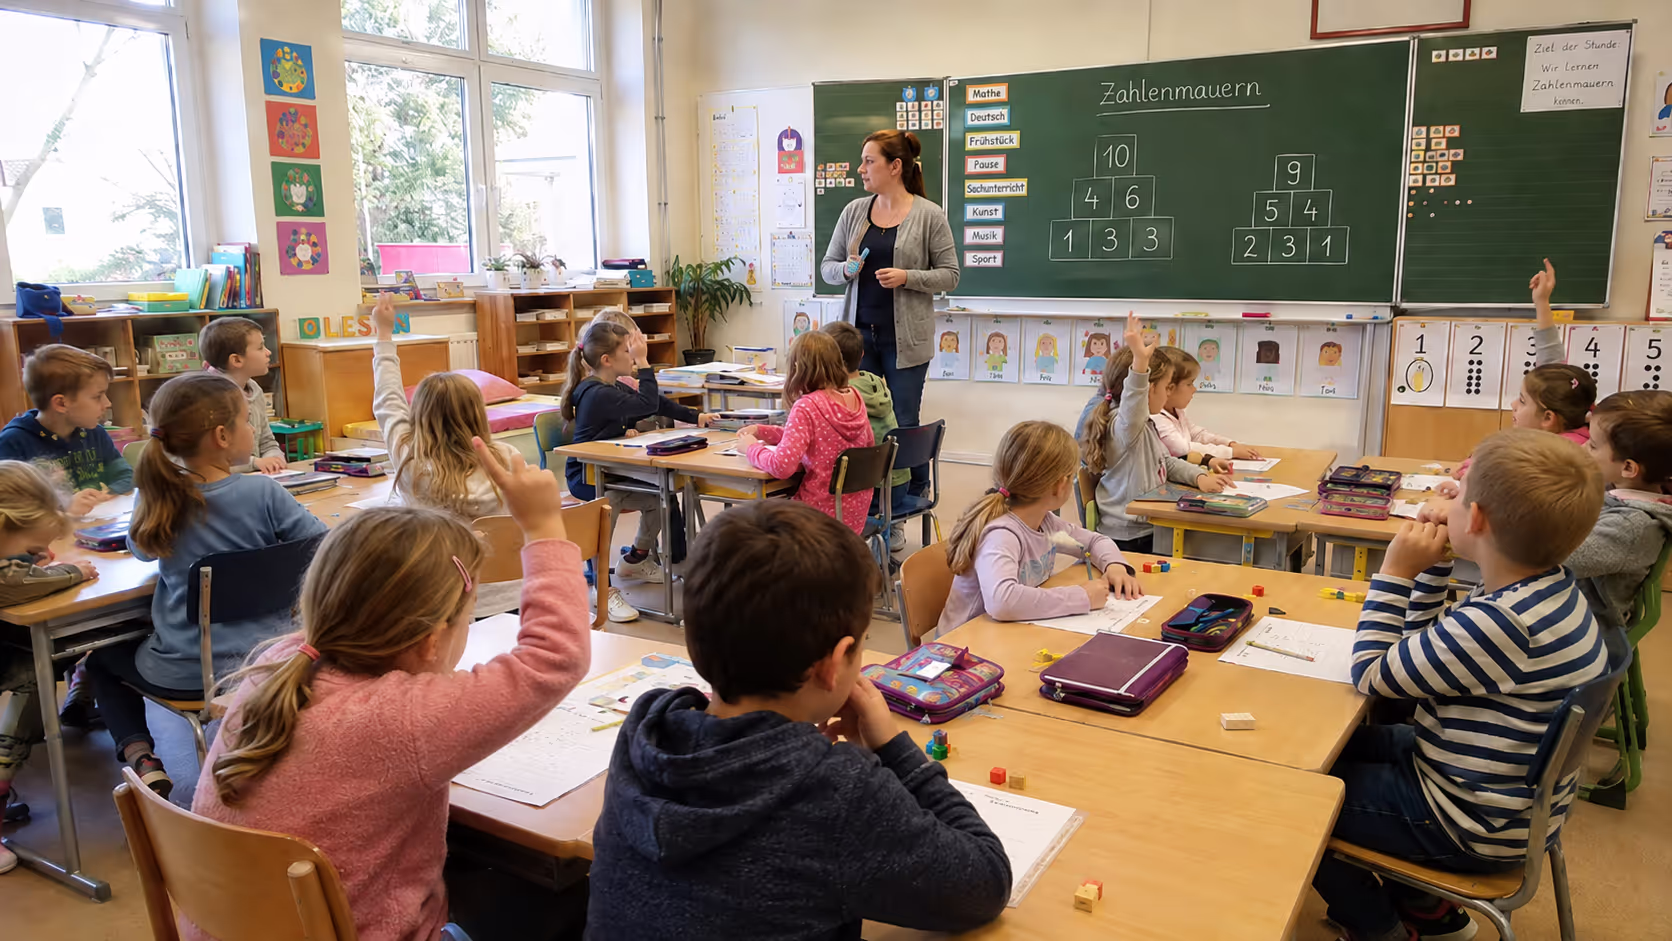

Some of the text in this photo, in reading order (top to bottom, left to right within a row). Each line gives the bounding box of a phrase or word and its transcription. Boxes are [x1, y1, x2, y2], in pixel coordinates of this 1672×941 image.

[1534, 41, 1554, 53] Ziel
[1562, 42, 1578, 51] der
[1541, 64, 1558, 72] Wir
[972, 89, 1001, 99] Mathe
[1100, 79, 1262, 105] Zahlenmauern
[1532, 79, 1614, 91] Zahlenmauern
[970, 111, 1005, 122] Deutsch
[969, 135, 1015, 146] Frühstück
[974, 160, 999, 169] Pause
[1103, 144, 1129, 168] 10
[1287, 161, 1301, 185] 9
[967, 183, 1025, 193] Sachunterricht
[1084, 185, 1140, 210] 4 6
[972, 207, 999, 216] Kunst
[1264, 199, 1318, 221] 5 4
[972, 231, 998, 240] Musik
[1063, 227, 1158, 252] 1 3 3
[1244, 235, 1331, 257] 2 3 1
[972, 254, 997, 265] Sport
[1415, 334, 1427, 355] 1
[1468, 335, 1484, 355] 2
[1525, 336, 1537, 356] 3
[1585, 337, 1600, 358] 4
[1646, 338, 1662, 360] 5
